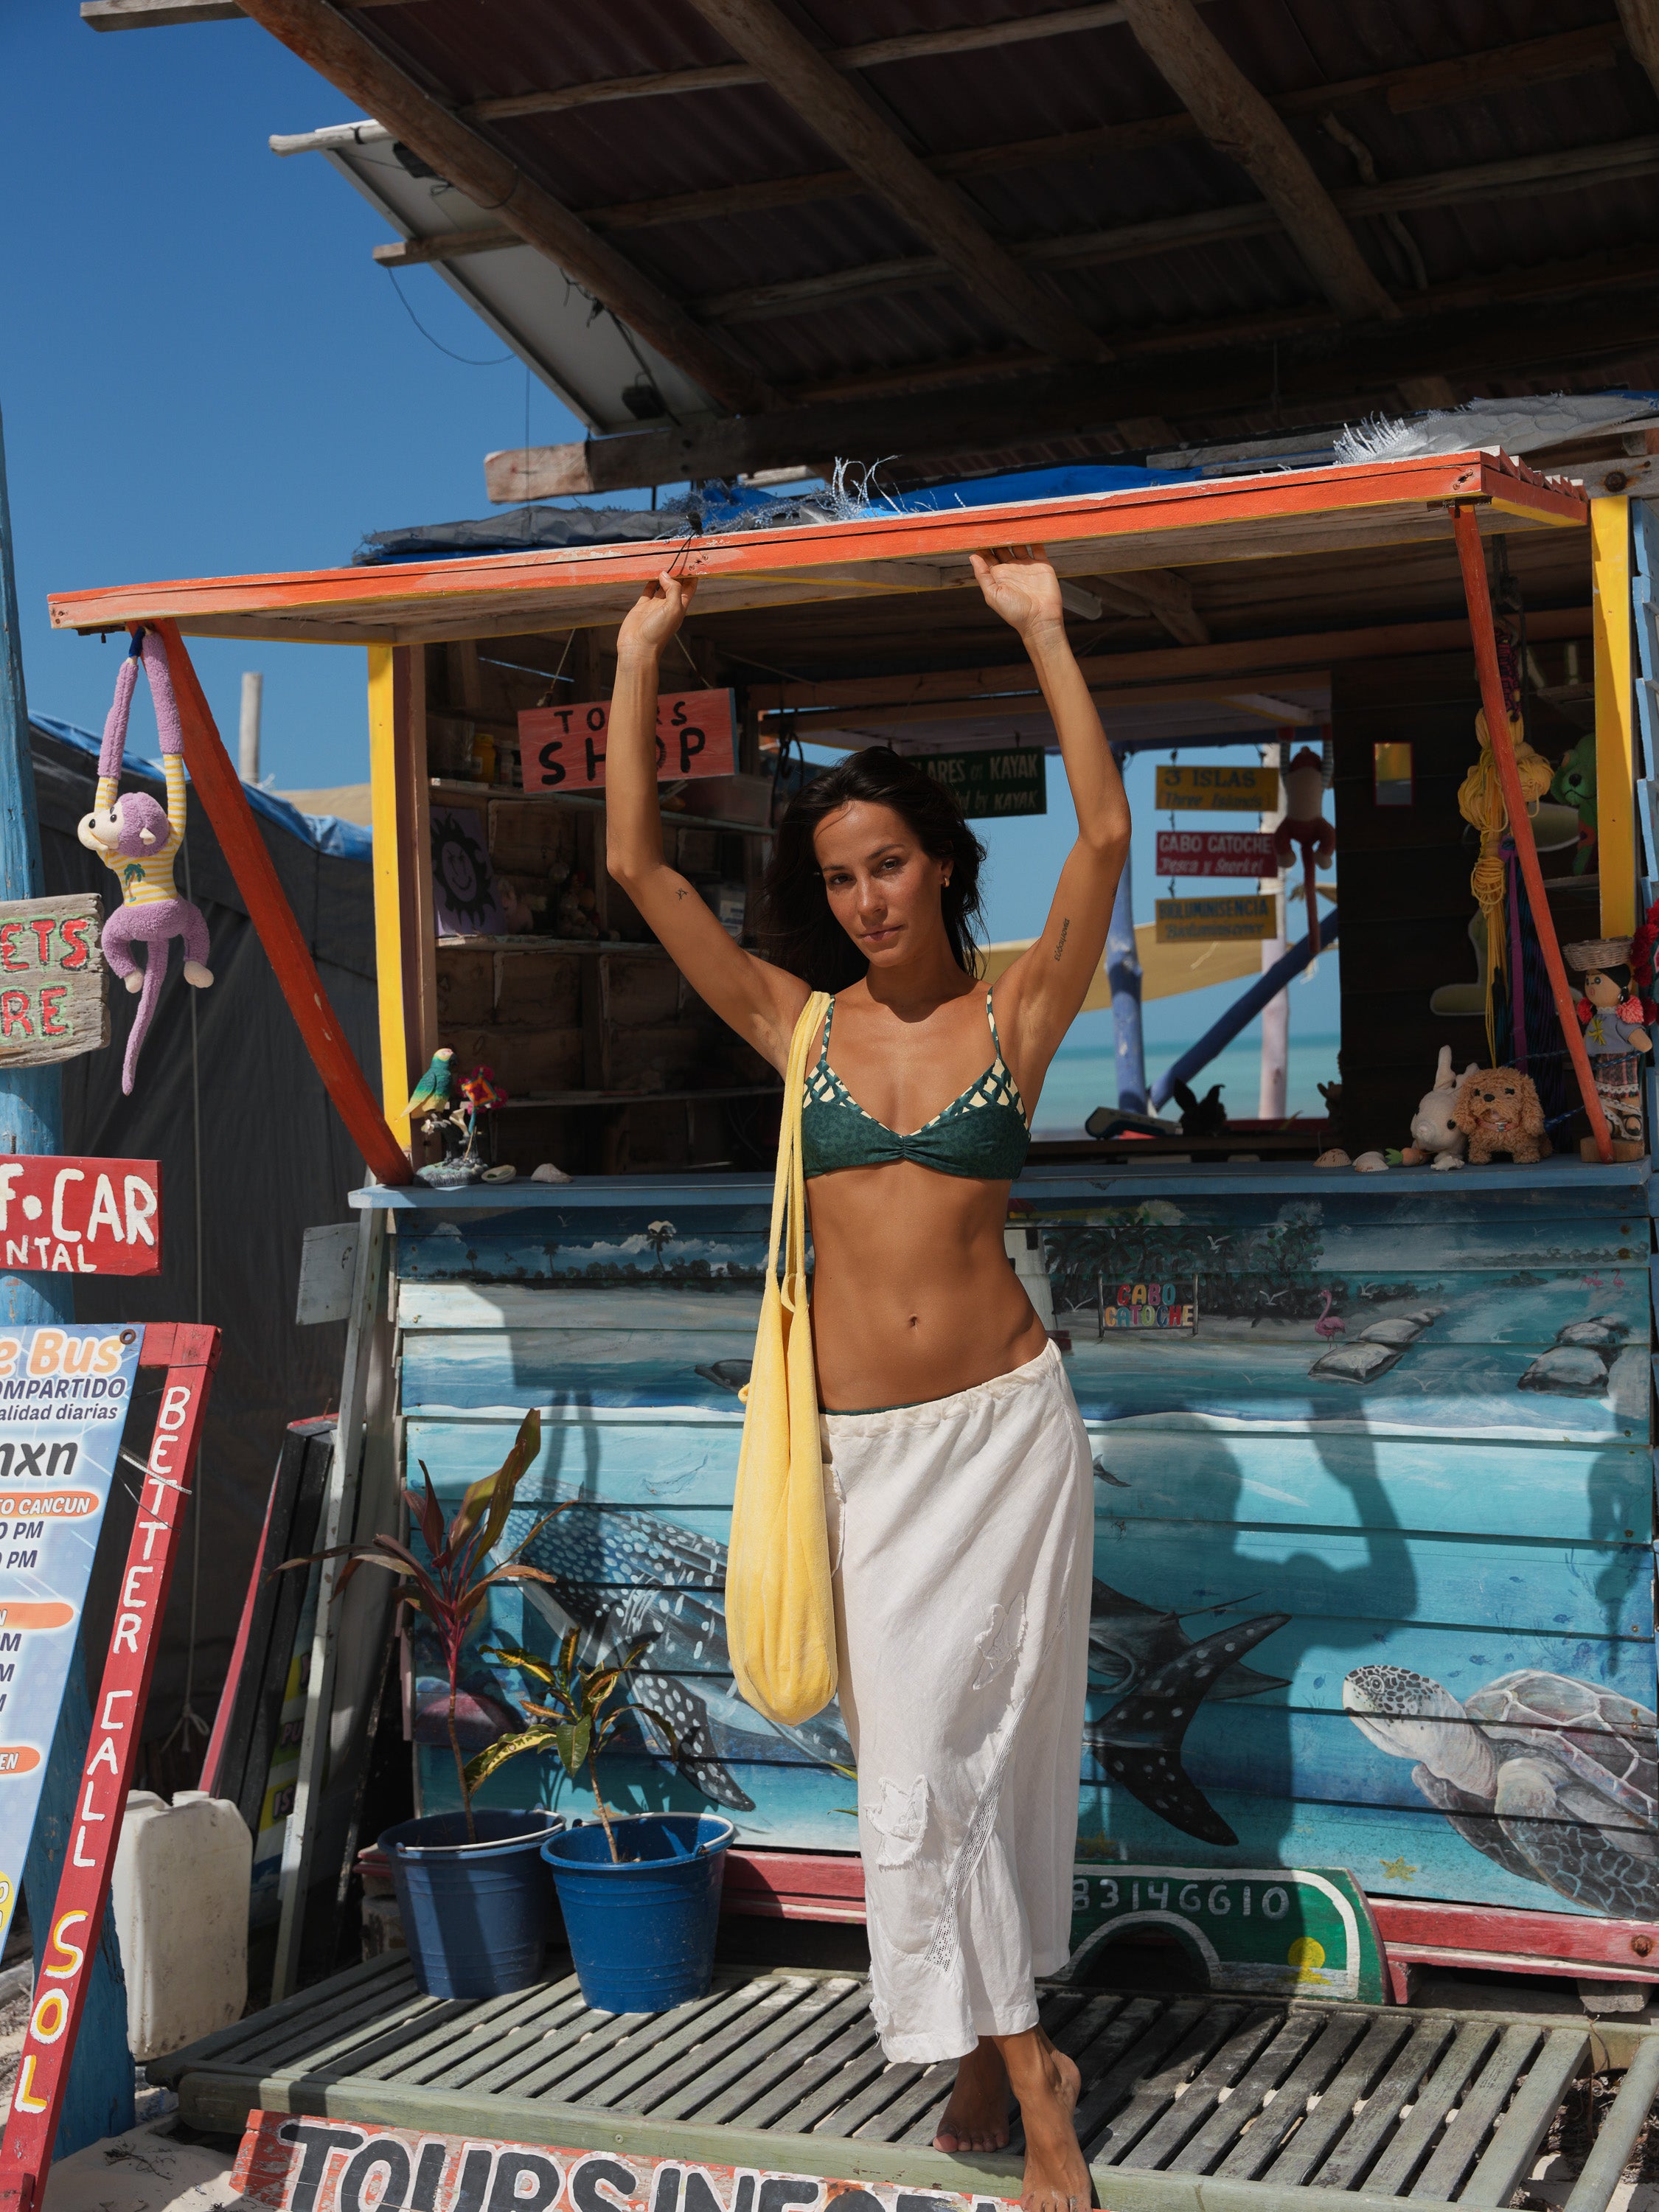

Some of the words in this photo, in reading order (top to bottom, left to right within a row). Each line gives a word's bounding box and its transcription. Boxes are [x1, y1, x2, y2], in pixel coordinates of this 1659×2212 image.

[553, 701, 687, 734] TOS
[990, 754, 1038, 780] KAYAK
[1164, 769, 1181, 787] 3
[1192, 769, 1256, 788] ISLAS
[995, 790, 1038, 810] KAYAK
[1158, 835, 1203, 852] CABO
[1207, 835, 1273, 854] CATOCHE
[0, 918, 91, 971] ETS
[0, 986, 68, 1037] RE
[6, 1235, 97, 1272] NTAL
[1116, 1283, 1176, 1306] CABO
[1105, 1304, 1194, 1327] CATOCHE
[29, 1330, 124, 1377] Bus
[0, 1378, 126, 1399] MPARTIDO
[56, 1403, 118, 1420] diarias
[18, 1496, 91, 1515] CANCUN
[13, 1520, 44, 1540] PM
[113, 1386, 191, 1653] BETTER
[7, 1550, 38, 1568] PM
[0, 1632, 21, 1652] M
[74, 1690, 133, 1868] CALL
[14, 1910, 88, 2113] SOL
